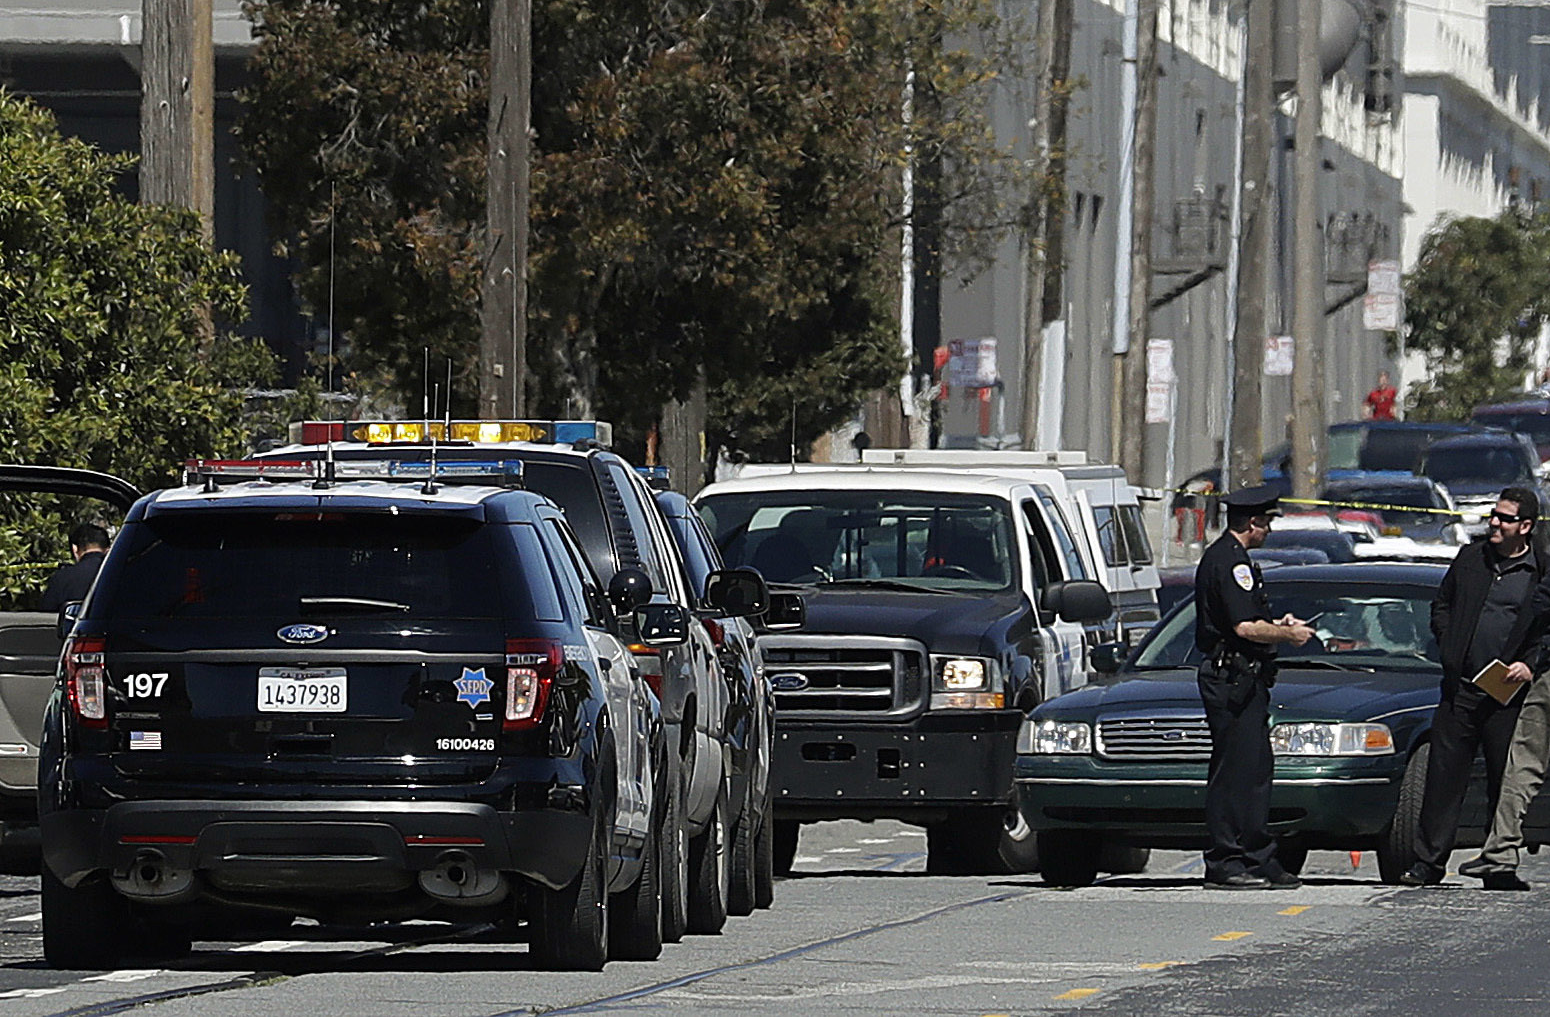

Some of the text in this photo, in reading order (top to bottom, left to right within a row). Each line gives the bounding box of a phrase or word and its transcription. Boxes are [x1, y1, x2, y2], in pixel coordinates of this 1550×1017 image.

[287, 626, 316, 639] Ford
[123, 673, 169, 698] 197
[265, 684, 340, 705] 1437938
[436, 738, 495, 751] 16100426
